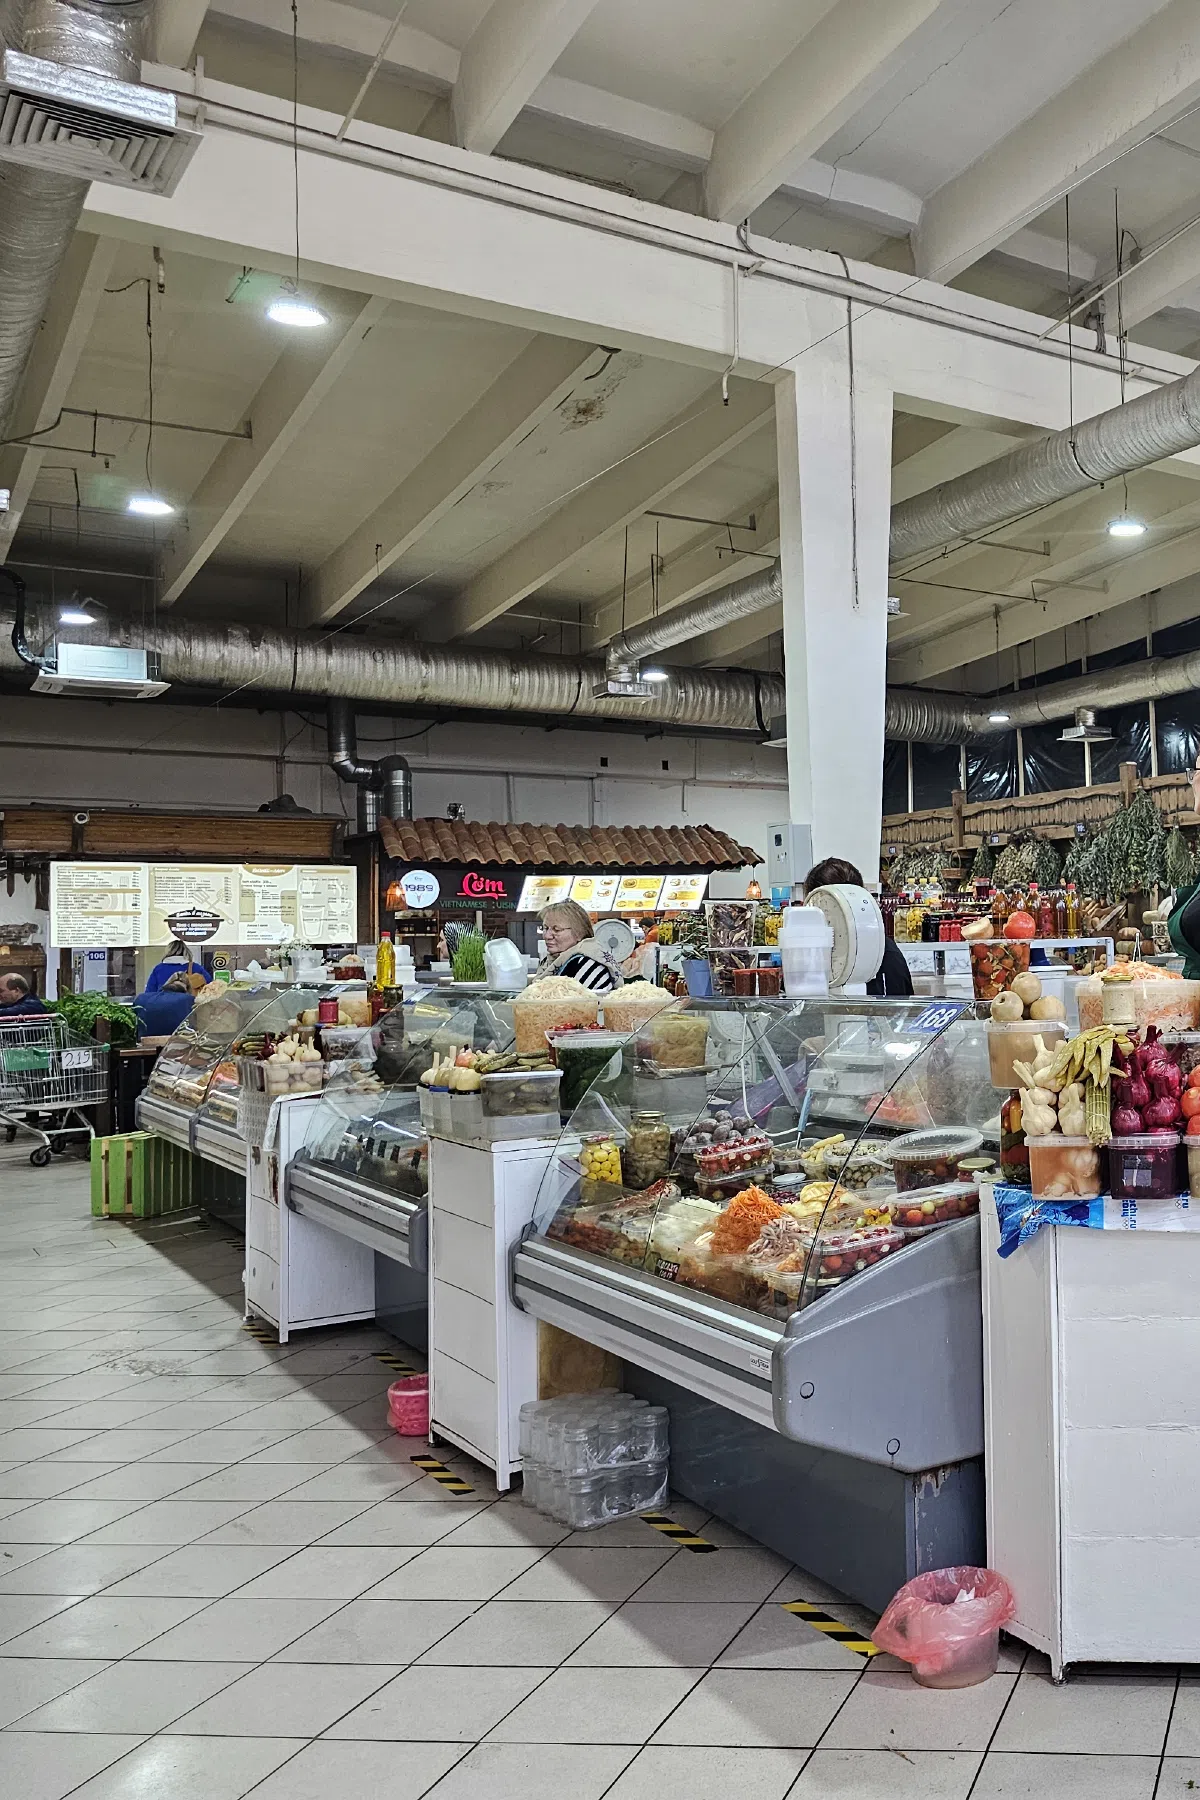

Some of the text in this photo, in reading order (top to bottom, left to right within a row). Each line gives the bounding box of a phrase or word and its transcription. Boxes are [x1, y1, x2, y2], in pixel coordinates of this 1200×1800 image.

[405, 884, 434, 892] 1989
[439, 900, 518, 909] VIETNAMESE UISIN
[89, 952, 105, 960] 106
[913, 1008, 958, 1028] 168
